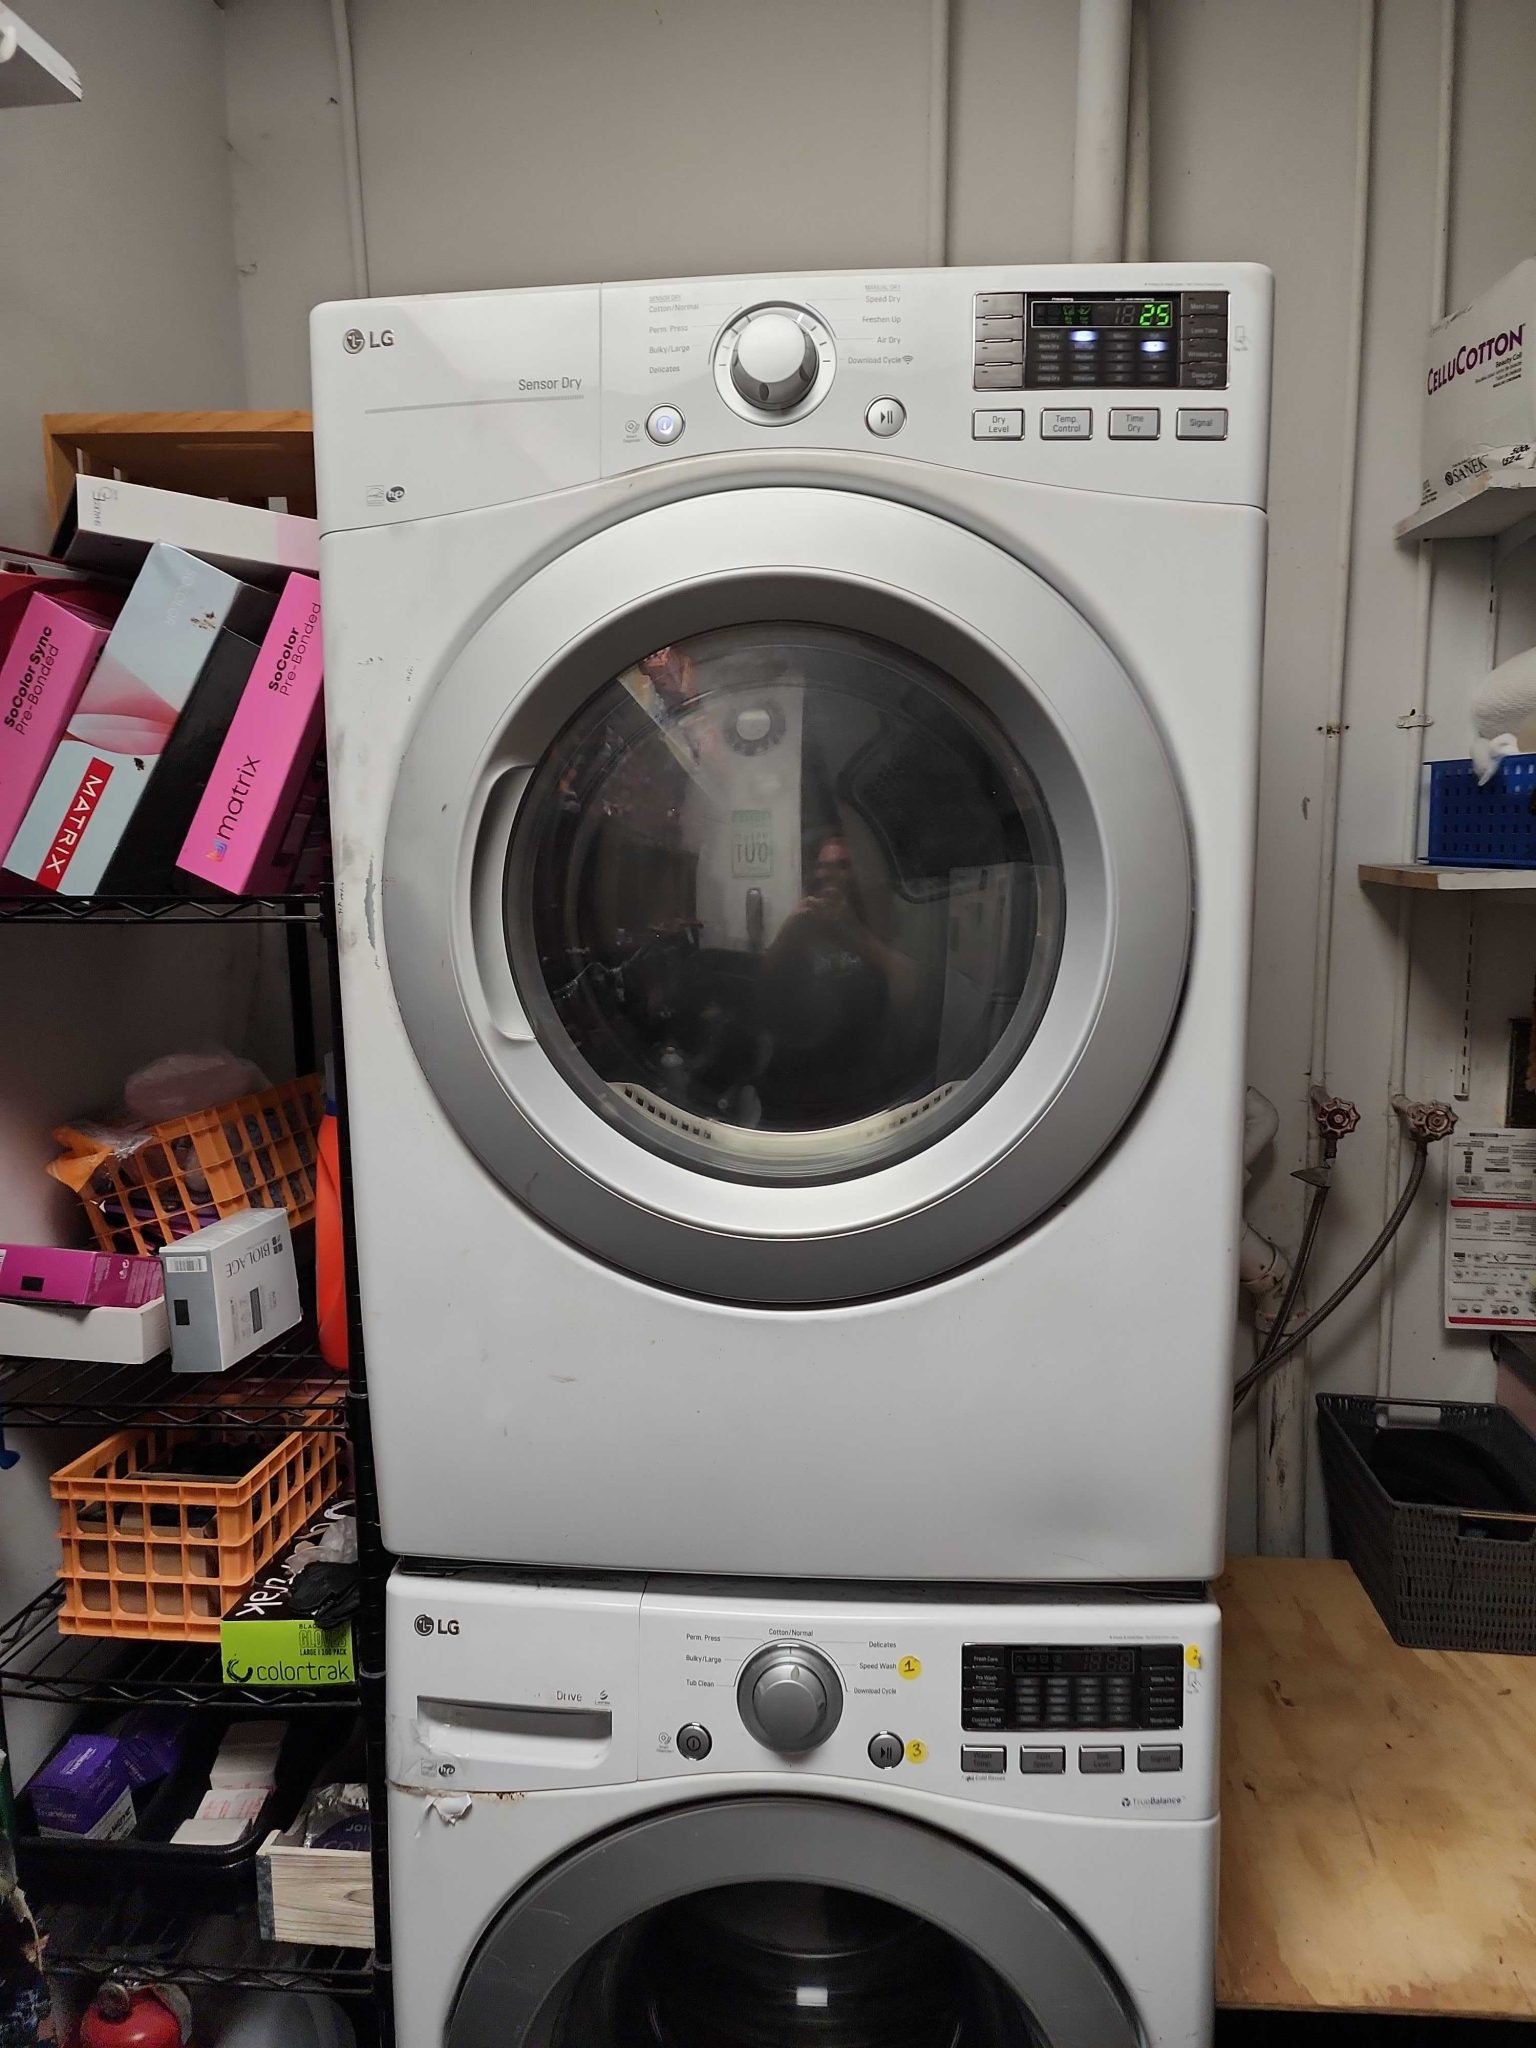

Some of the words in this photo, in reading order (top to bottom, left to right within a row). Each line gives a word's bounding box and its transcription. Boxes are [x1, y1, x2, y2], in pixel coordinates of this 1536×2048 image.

[865, 295, 888, 303] Speed
[888, 295, 901, 303] Dry
[648, 303, 700, 313] Cotton/Normal
[891, 315, 902, 324] Up
[1139, 303, 1170, 326] 25
[369, 329, 395, 348] LG
[888, 336, 901, 344] Dry
[649, 345, 690, 354] Bulky/Large
[847, 356, 882, 364] Download
[882, 356, 902, 365] Cycle
[649, 366, 681, 374] Delicates
[518, 378, 559, 391] Sensor
[561, 376, 582, 391] Dry
[992, 416, 1006, 425] Dry
[1125, 414, 1144, 423] Time
[1189, 418, 1213, 428] Signal
[988, 424, 1009, 433] Level
[1053, 424, 1081, 433] Control
[1127, 423, 1141, 433] Dry
[1453, 456, 1488, 483] SANEK
[279, 602, 321, 696] Pre-Bonded
[268, 627, 299, 691] SoColor
[4, 665, 35, 728] SoColor
[29, 626, 52, 665] Sync
[15, 643, 59, 736] Pre-Bonded
[217, 755, 261, 840] matrix
[45, 774, 103, 874] MATRIX
[224, 1242, 271, 1279] BIOLAGE
[437, 1619, 459, 1635] LG
[768, 1628, 814, 1637] Cotton/Normal
[685, 1655, 722, 1664] Bulky/Large
[256, 1660, 350, 1682] colortrak
[859, 1662, 879, 1670] Speed
[903, 1660, 915, 1673] 1
[698, 1679, 715, 1688] Clean
[881, 1687, 897, 1695] Cycle
[912, 1743, 922, 1757] 3
[345, 1824, 368, 1832] JOI
